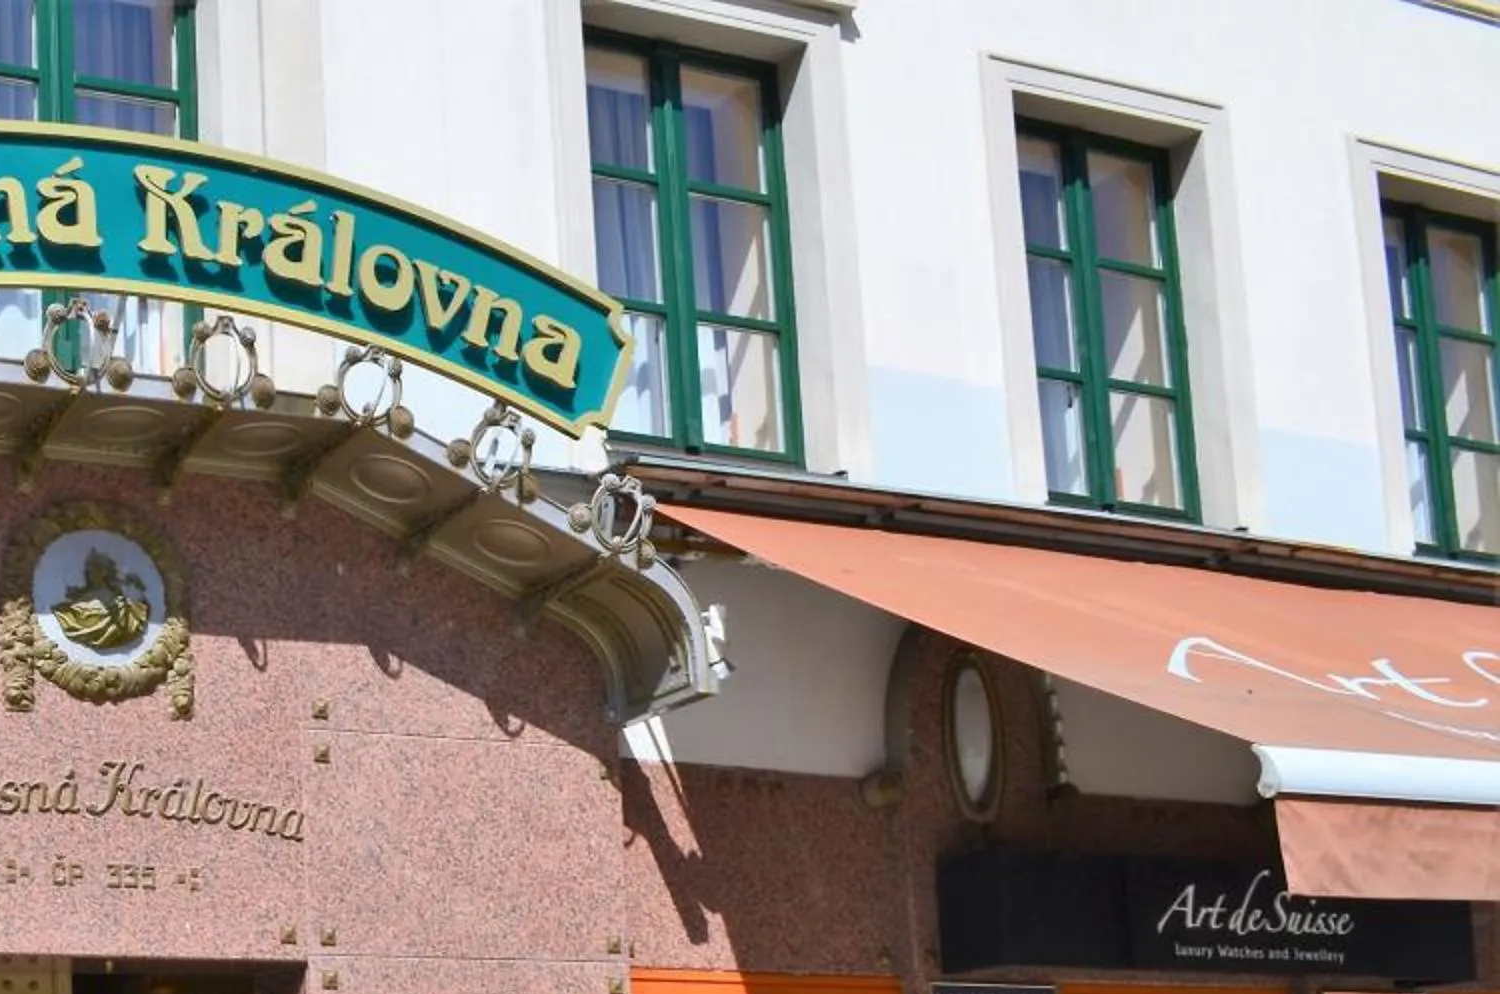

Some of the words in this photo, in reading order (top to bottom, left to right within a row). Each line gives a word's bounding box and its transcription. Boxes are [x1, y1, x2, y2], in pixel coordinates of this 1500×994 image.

[136, 163, 586, 391] Královna
[85, 760, 305, 843] Královna
[106, 863, 157, 891] 335
[1175, 943, 1213, 960] Luxury
[1216, 944, 1265, 960] Watches
[1268, 946, 1290, 960] and
[1293, 947, 1345, 965] Jewellery
